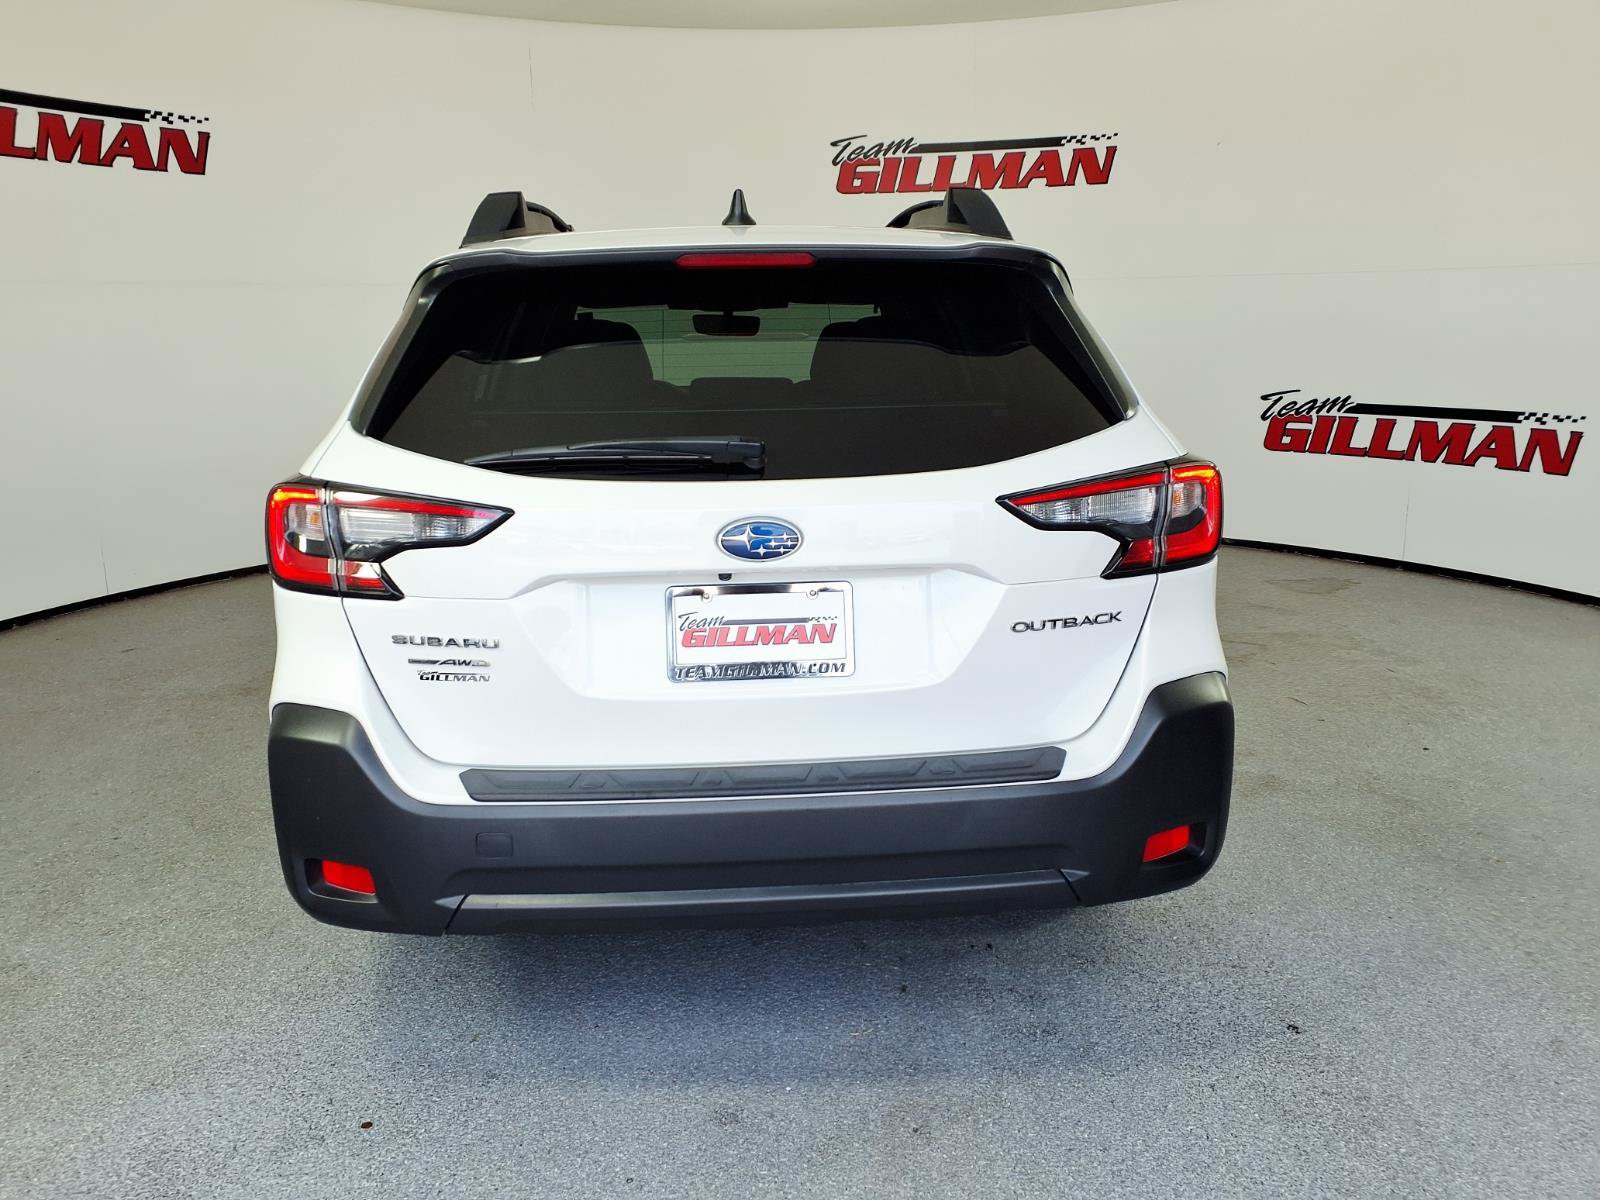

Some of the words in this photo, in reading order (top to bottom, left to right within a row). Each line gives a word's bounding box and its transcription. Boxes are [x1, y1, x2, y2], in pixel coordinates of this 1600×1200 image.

[830, 135, 914, 166] Team
[836, 146, 1117, 194] GILLMAN
[1260, 389, 1353, 421] Team
[1263, 414, 1583, 476] GILLMAN
[678, 611, 725, 631] Team
[1011, 611, 1122, 633] OUTBACK
[391, 635, 499, 649] SUBARU
[681, 623, 837, 648] GILLMAN
[438, 659, 491, 667] AWD
[674, 662, 846, 680] TEAMGILLMAN.COM
[420, 674, 490, 682] GILLMAN
